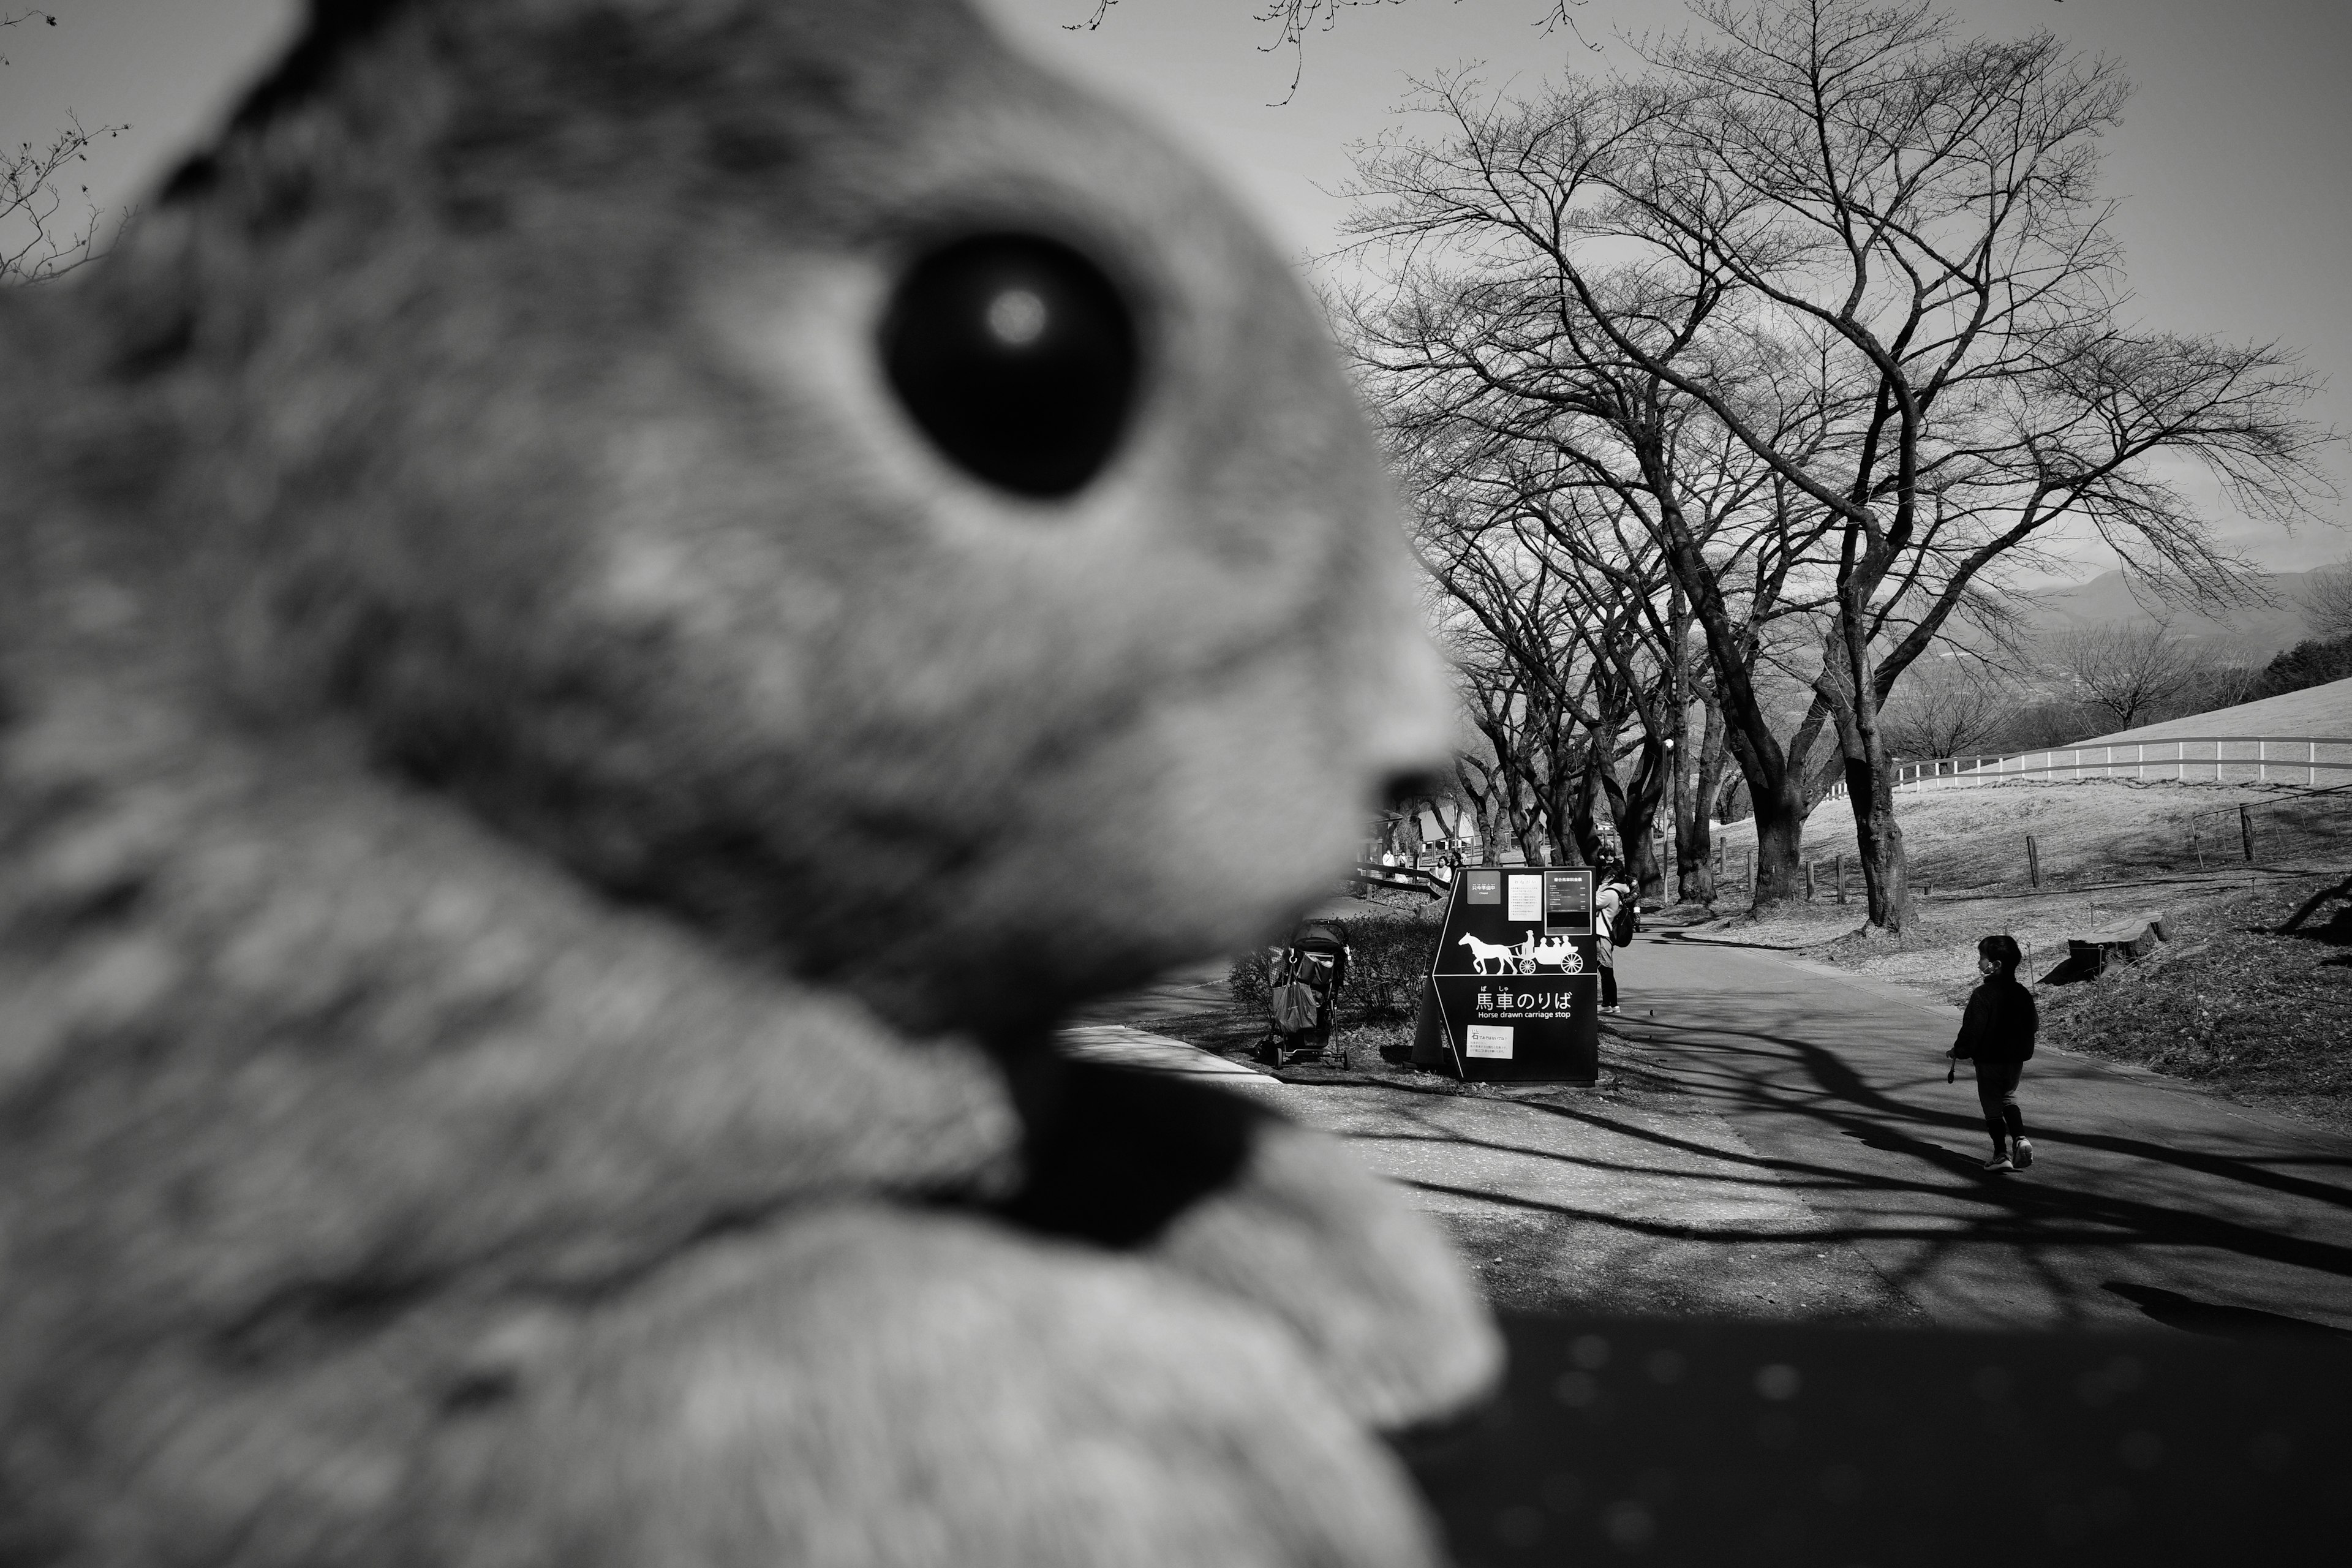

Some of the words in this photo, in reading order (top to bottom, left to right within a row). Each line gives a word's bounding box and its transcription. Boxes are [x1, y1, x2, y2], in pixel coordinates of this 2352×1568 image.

[1476, 991, 1573, 1011] 馬車のりば
[1525, 1011, 1553, 1019] carriage
[1555, 1011, 1571, 1019] stop
